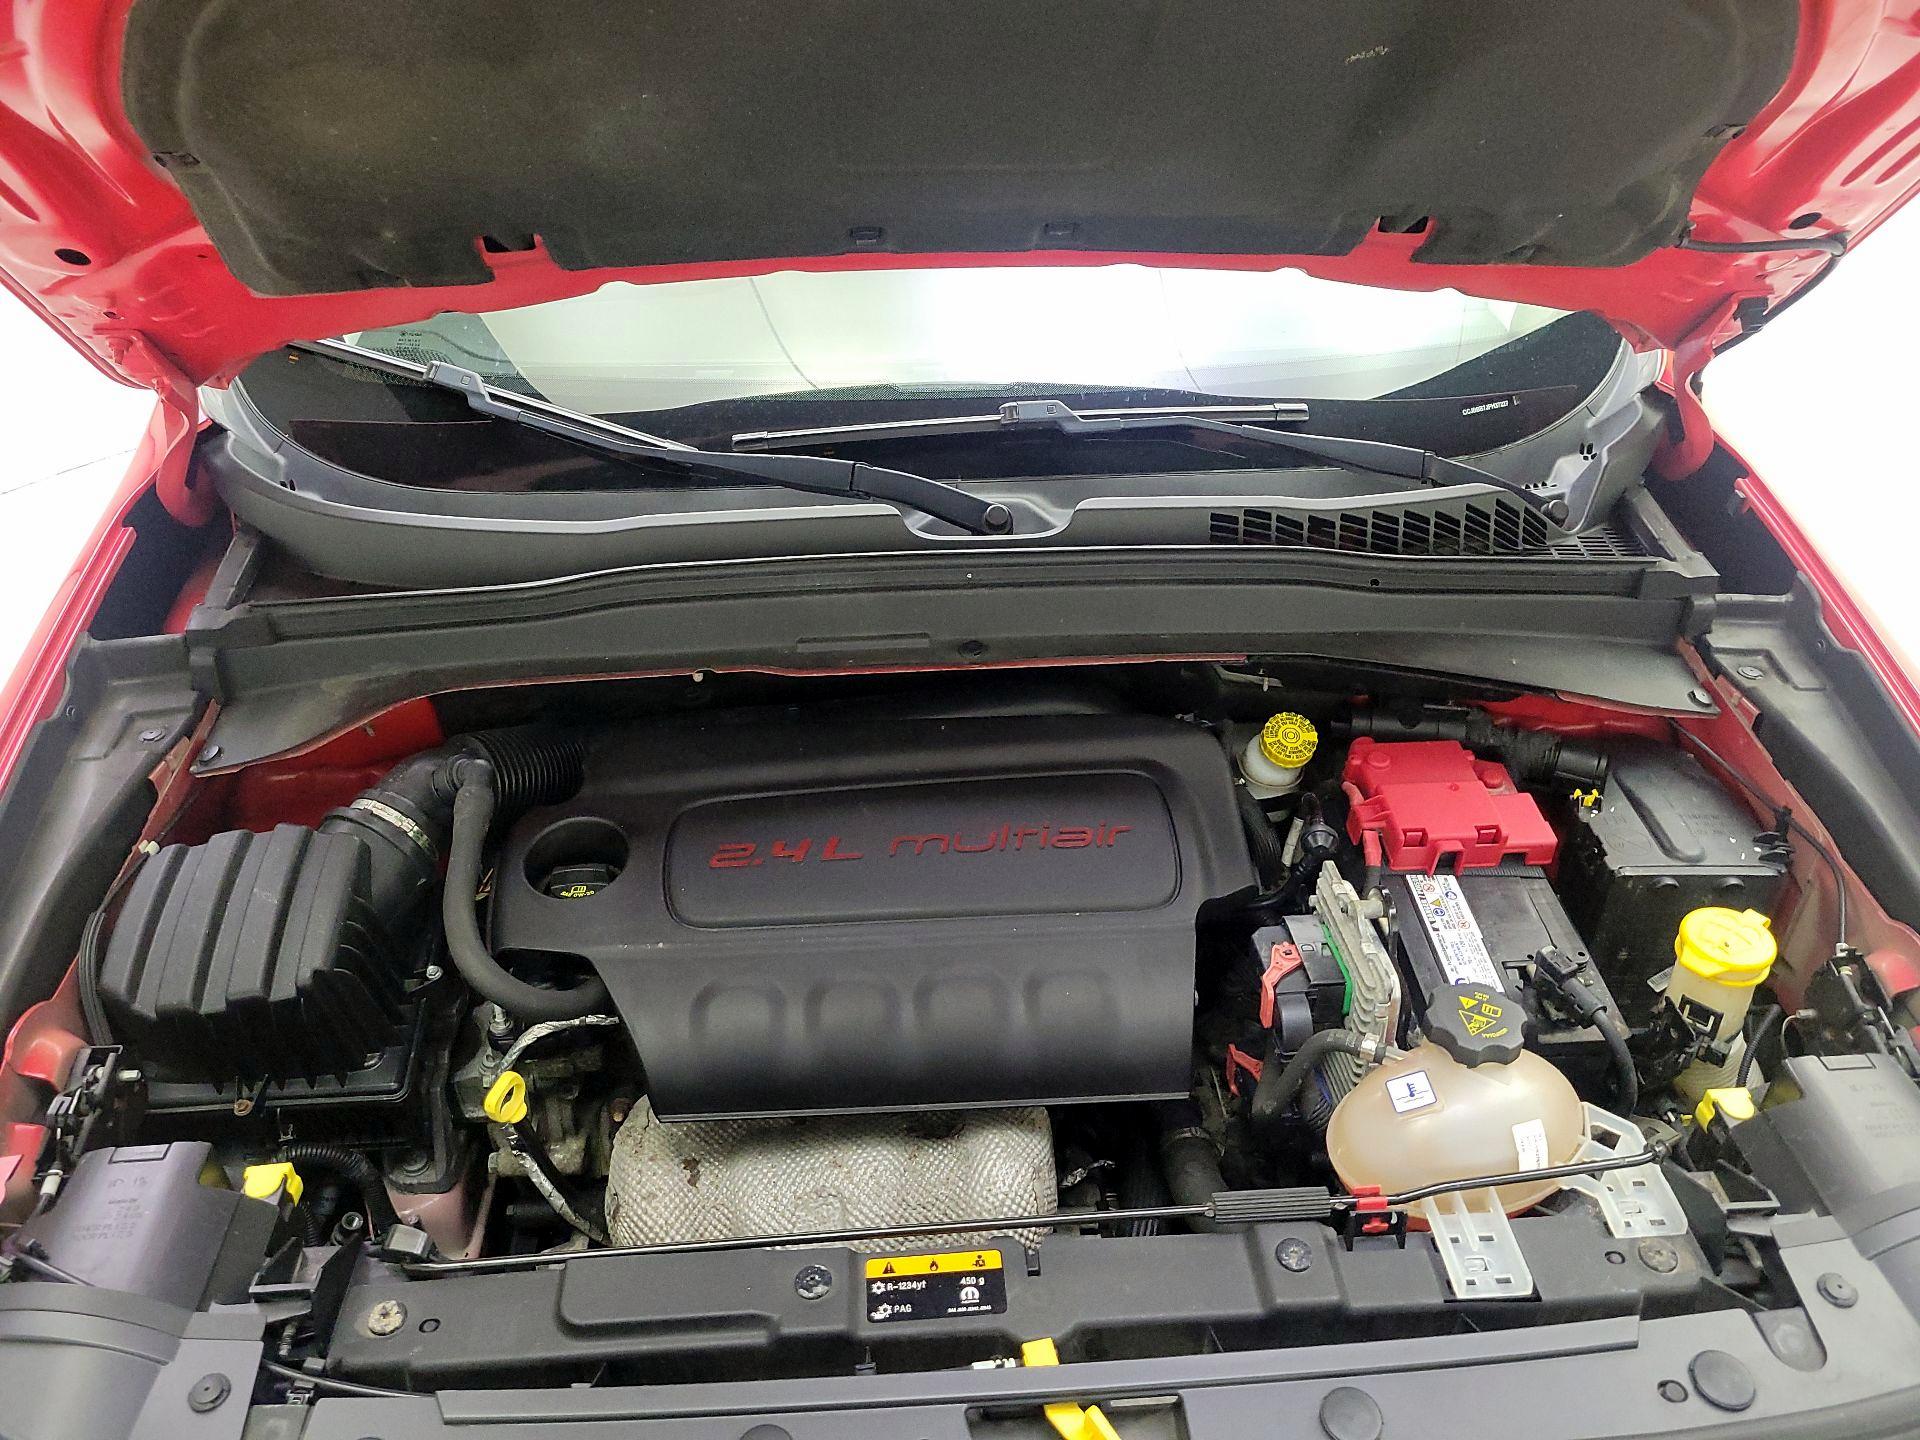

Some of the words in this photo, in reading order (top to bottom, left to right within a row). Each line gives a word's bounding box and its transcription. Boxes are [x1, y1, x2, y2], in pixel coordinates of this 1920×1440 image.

[889, 820, 1134, 856] multiair
[960, 1276, 977, 1286] 450
[978, 1277, 985, 1286] g
[893, 1303, 912, 1313] PAG
